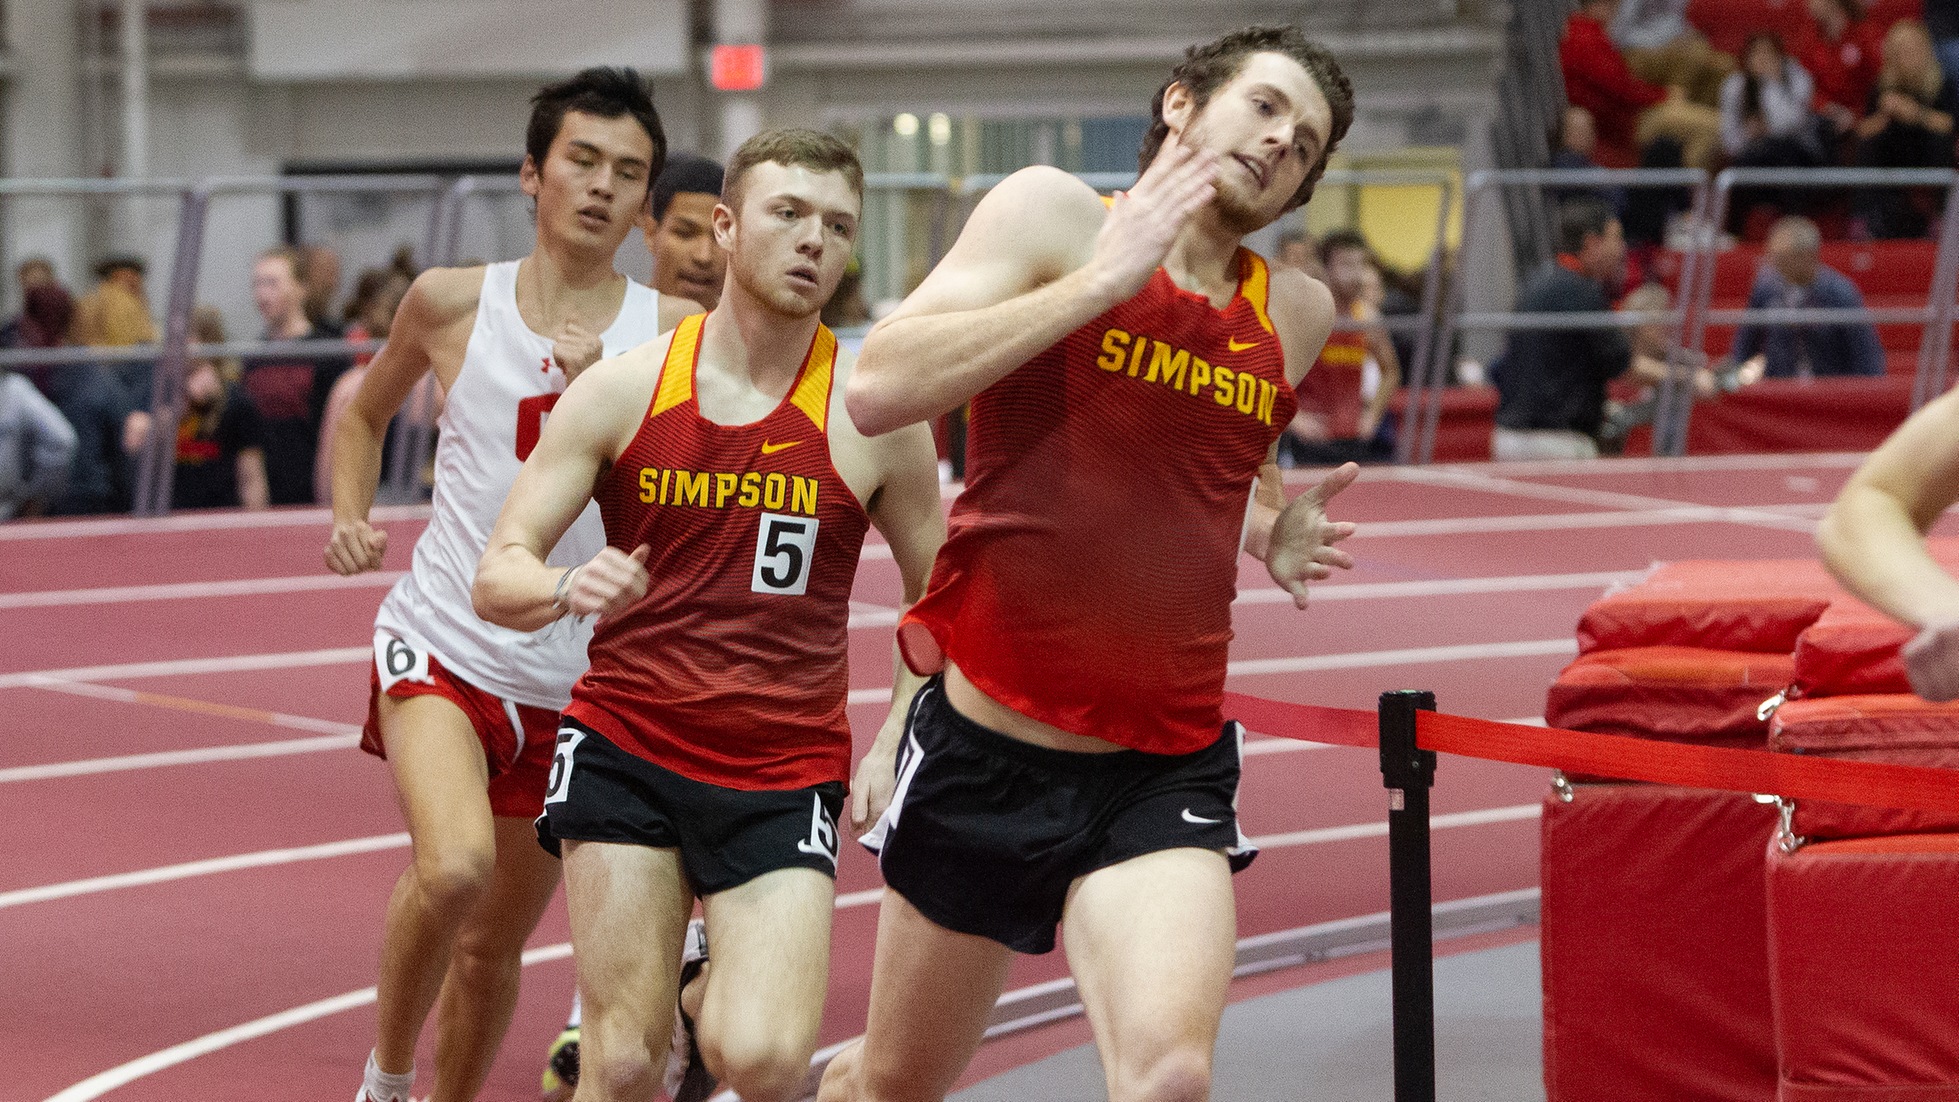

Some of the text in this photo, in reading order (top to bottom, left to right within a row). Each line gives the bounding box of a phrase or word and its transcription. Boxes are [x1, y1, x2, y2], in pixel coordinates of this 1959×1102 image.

[1096, 328, 1279, 426] SIMPSON
[638, 467, 819, 516] SIMPSON
[761, 520, 806, 589] 5
[386, 637, 416, 676] 6
